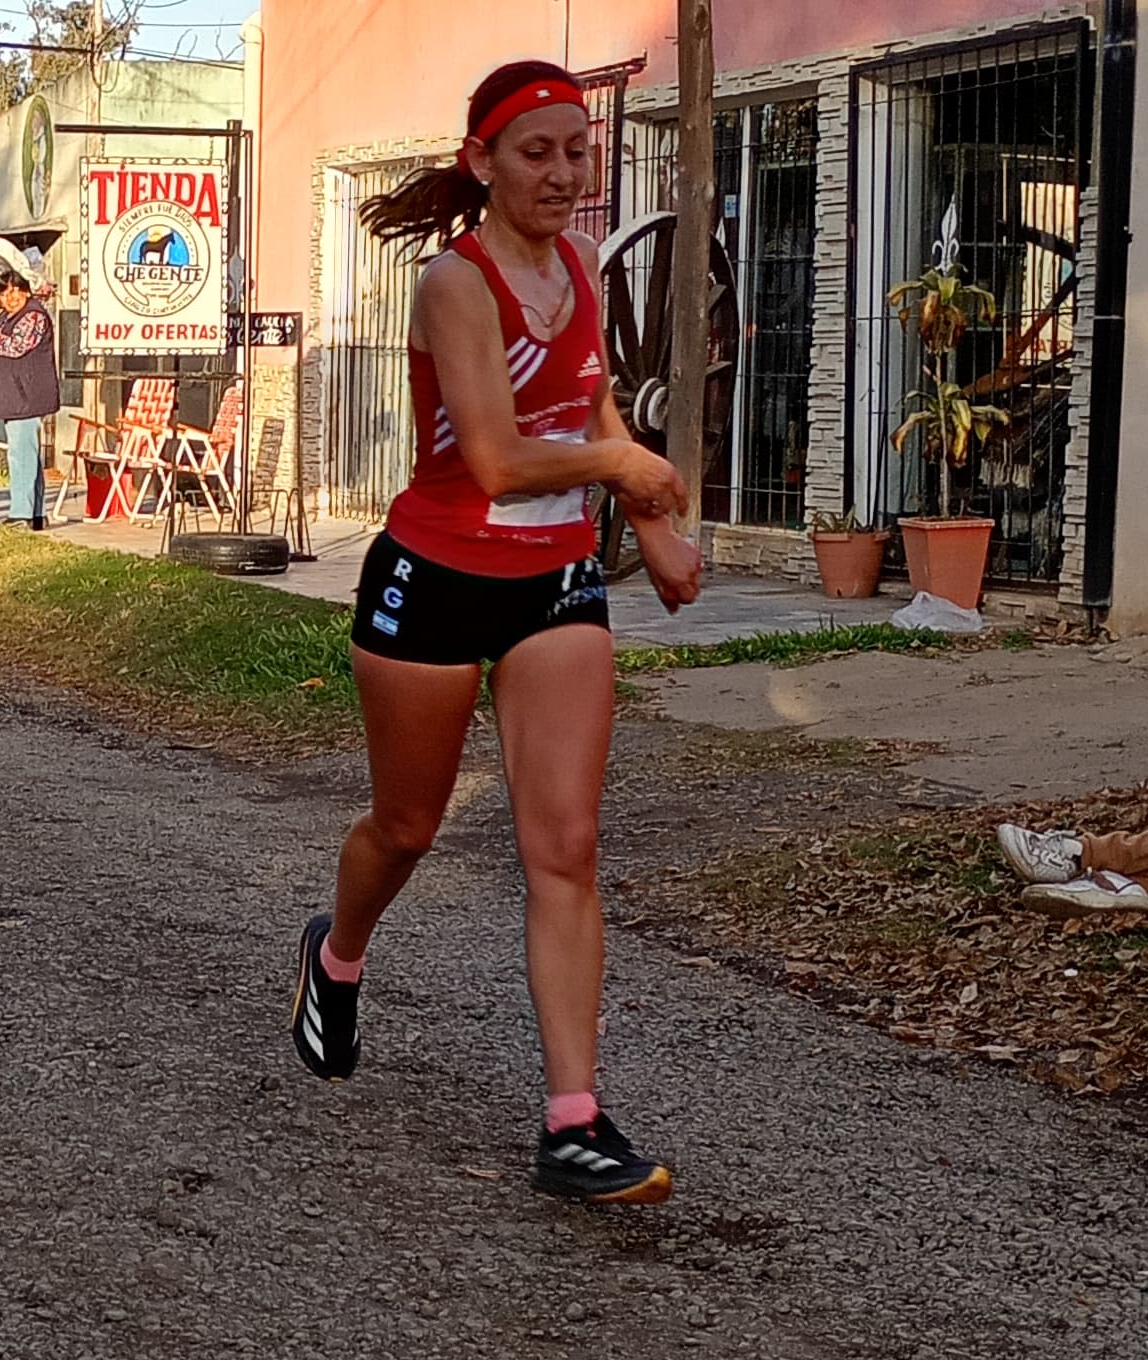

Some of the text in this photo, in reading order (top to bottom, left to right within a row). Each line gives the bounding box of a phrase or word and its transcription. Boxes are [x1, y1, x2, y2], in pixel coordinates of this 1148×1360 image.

[114, 266, 204, 284] CHE GENTE
[95, 323, 134, 340] HOY
[141, 323, 218, 340] OFERTAS
[393, 558, 413, 582] R
[383, 586, 403, 609] G
